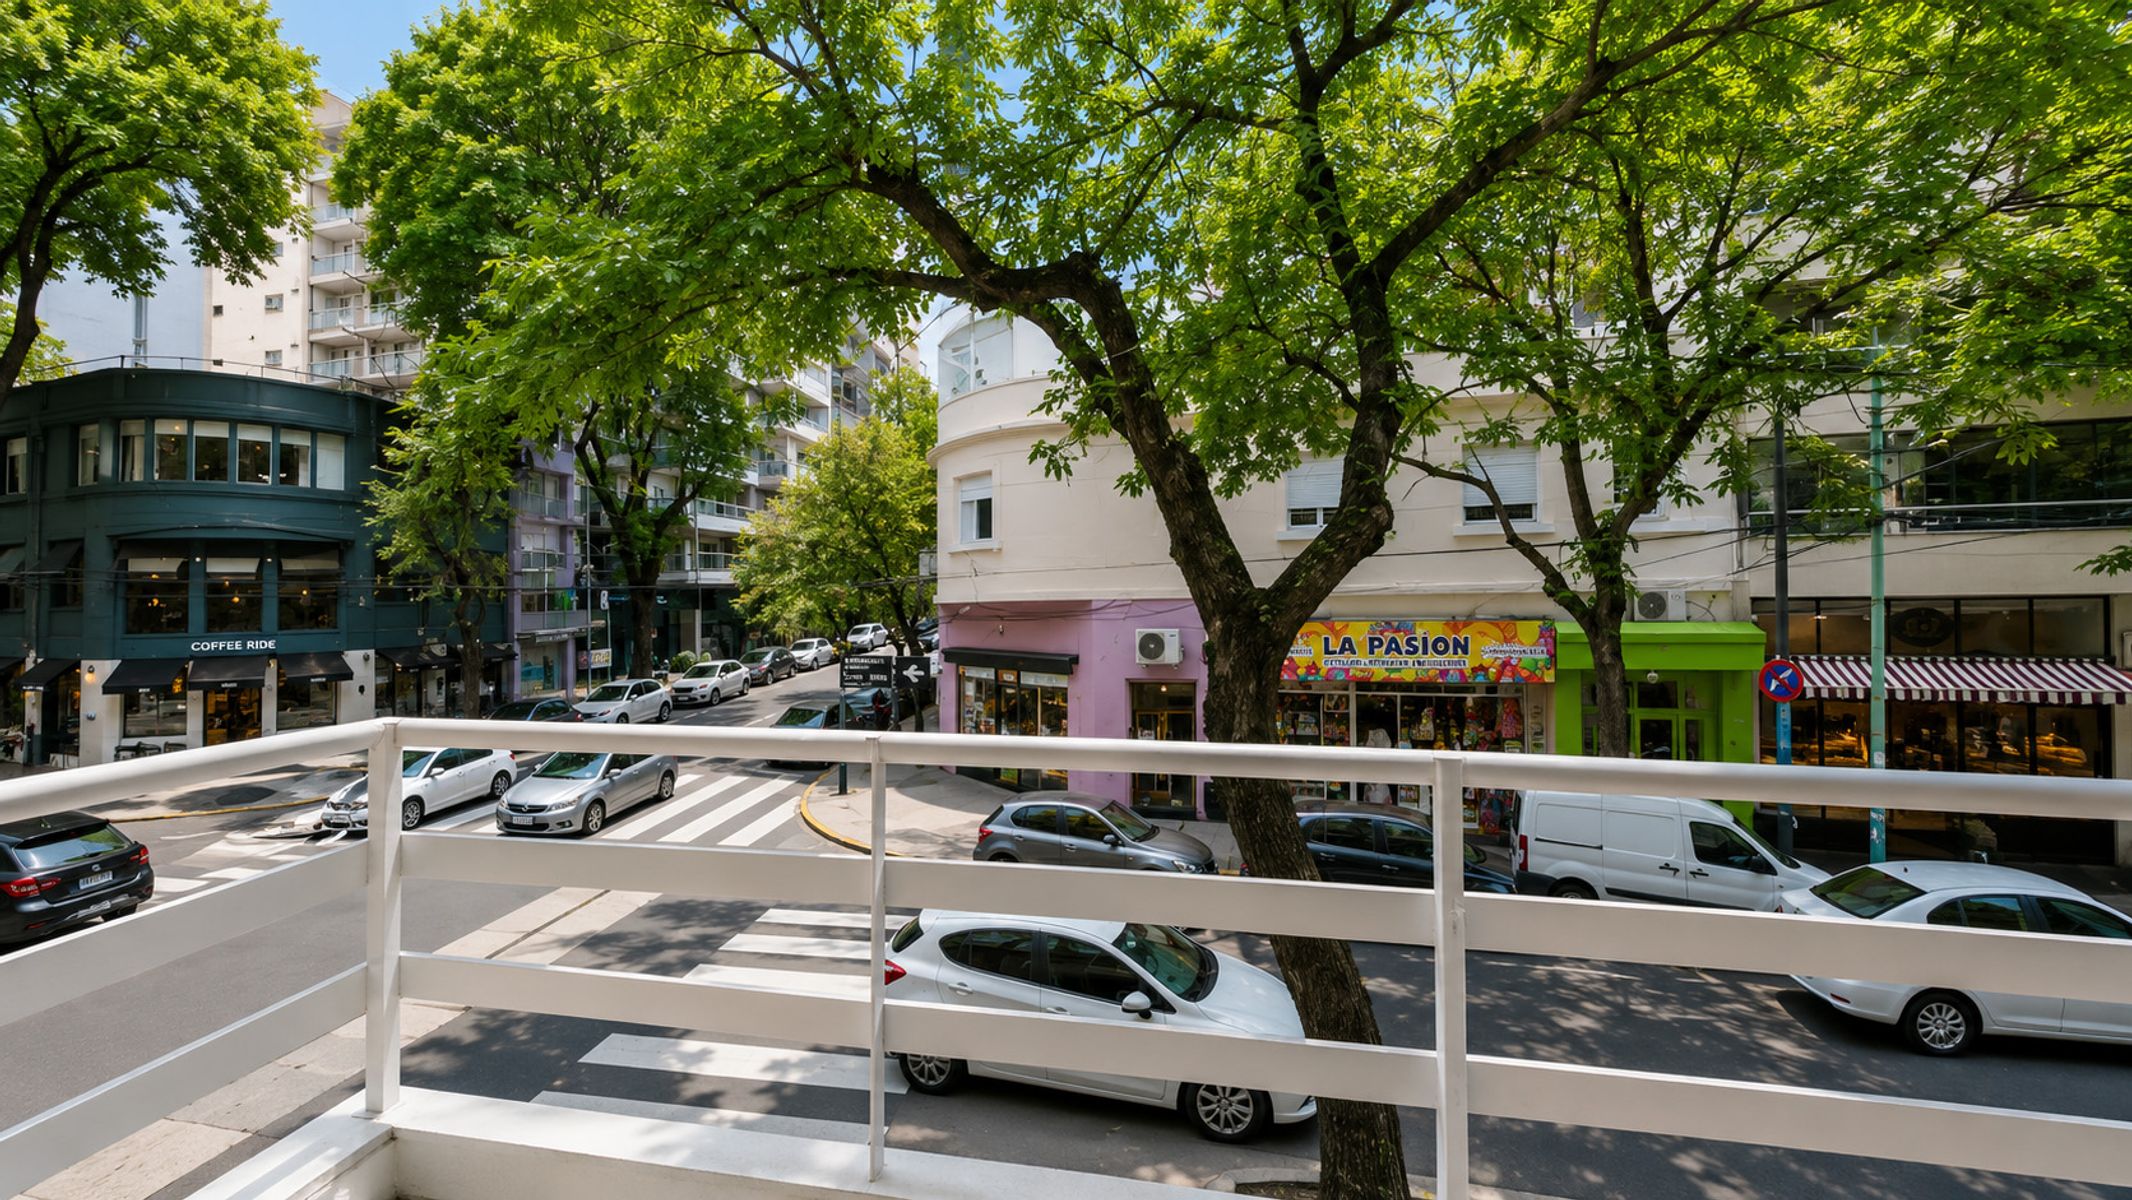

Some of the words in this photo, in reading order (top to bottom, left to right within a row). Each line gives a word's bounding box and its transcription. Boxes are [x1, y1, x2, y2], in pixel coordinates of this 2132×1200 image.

[191, 641, 243, 651] COFFEE
[246, 640, 276, 649] RIDE
[1323, 636, 1357, 656] LA
